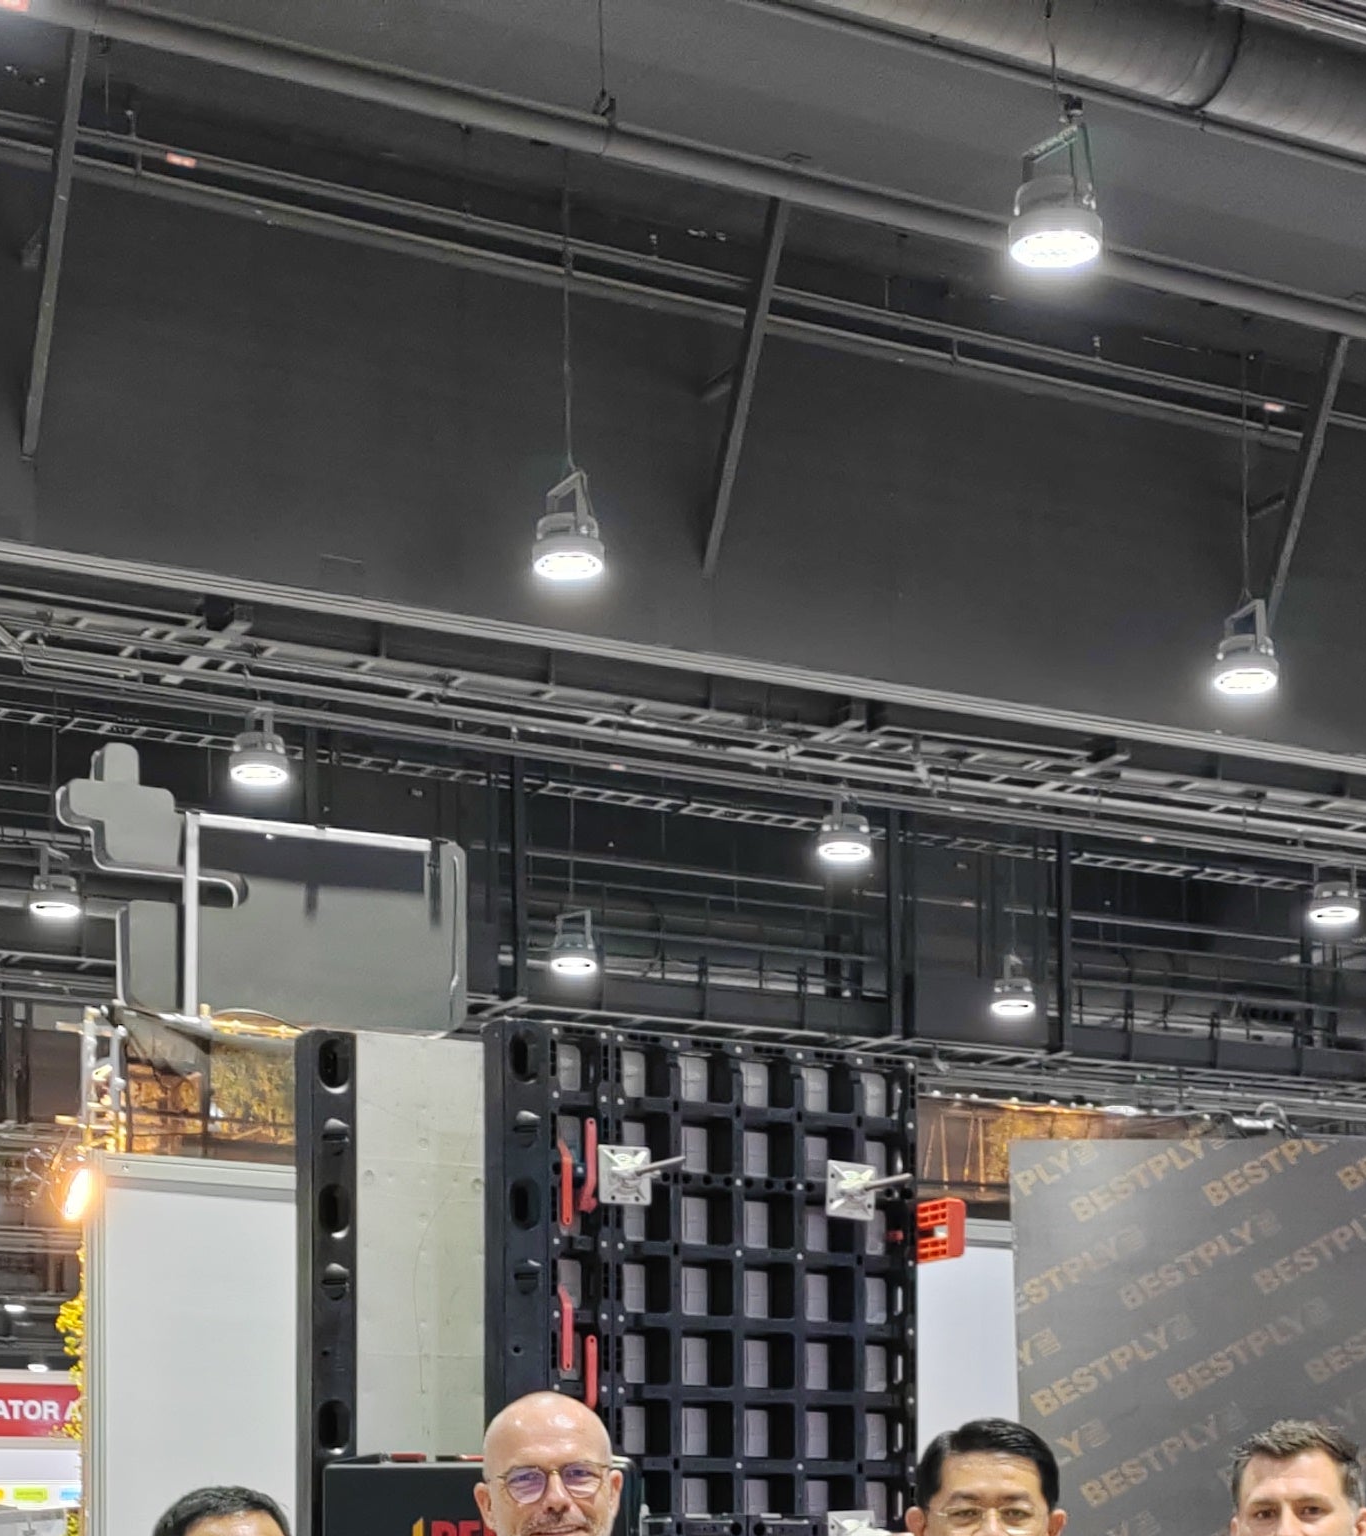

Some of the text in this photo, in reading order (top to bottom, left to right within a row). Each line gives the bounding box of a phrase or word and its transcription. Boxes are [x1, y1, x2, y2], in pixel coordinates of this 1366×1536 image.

[1120, 1220, 1255, 1311] BESTPLY
[1030, 1325, 1170, 1418] BESTPLY
[1079, 1413, 1219, 1508] BESTPLY
